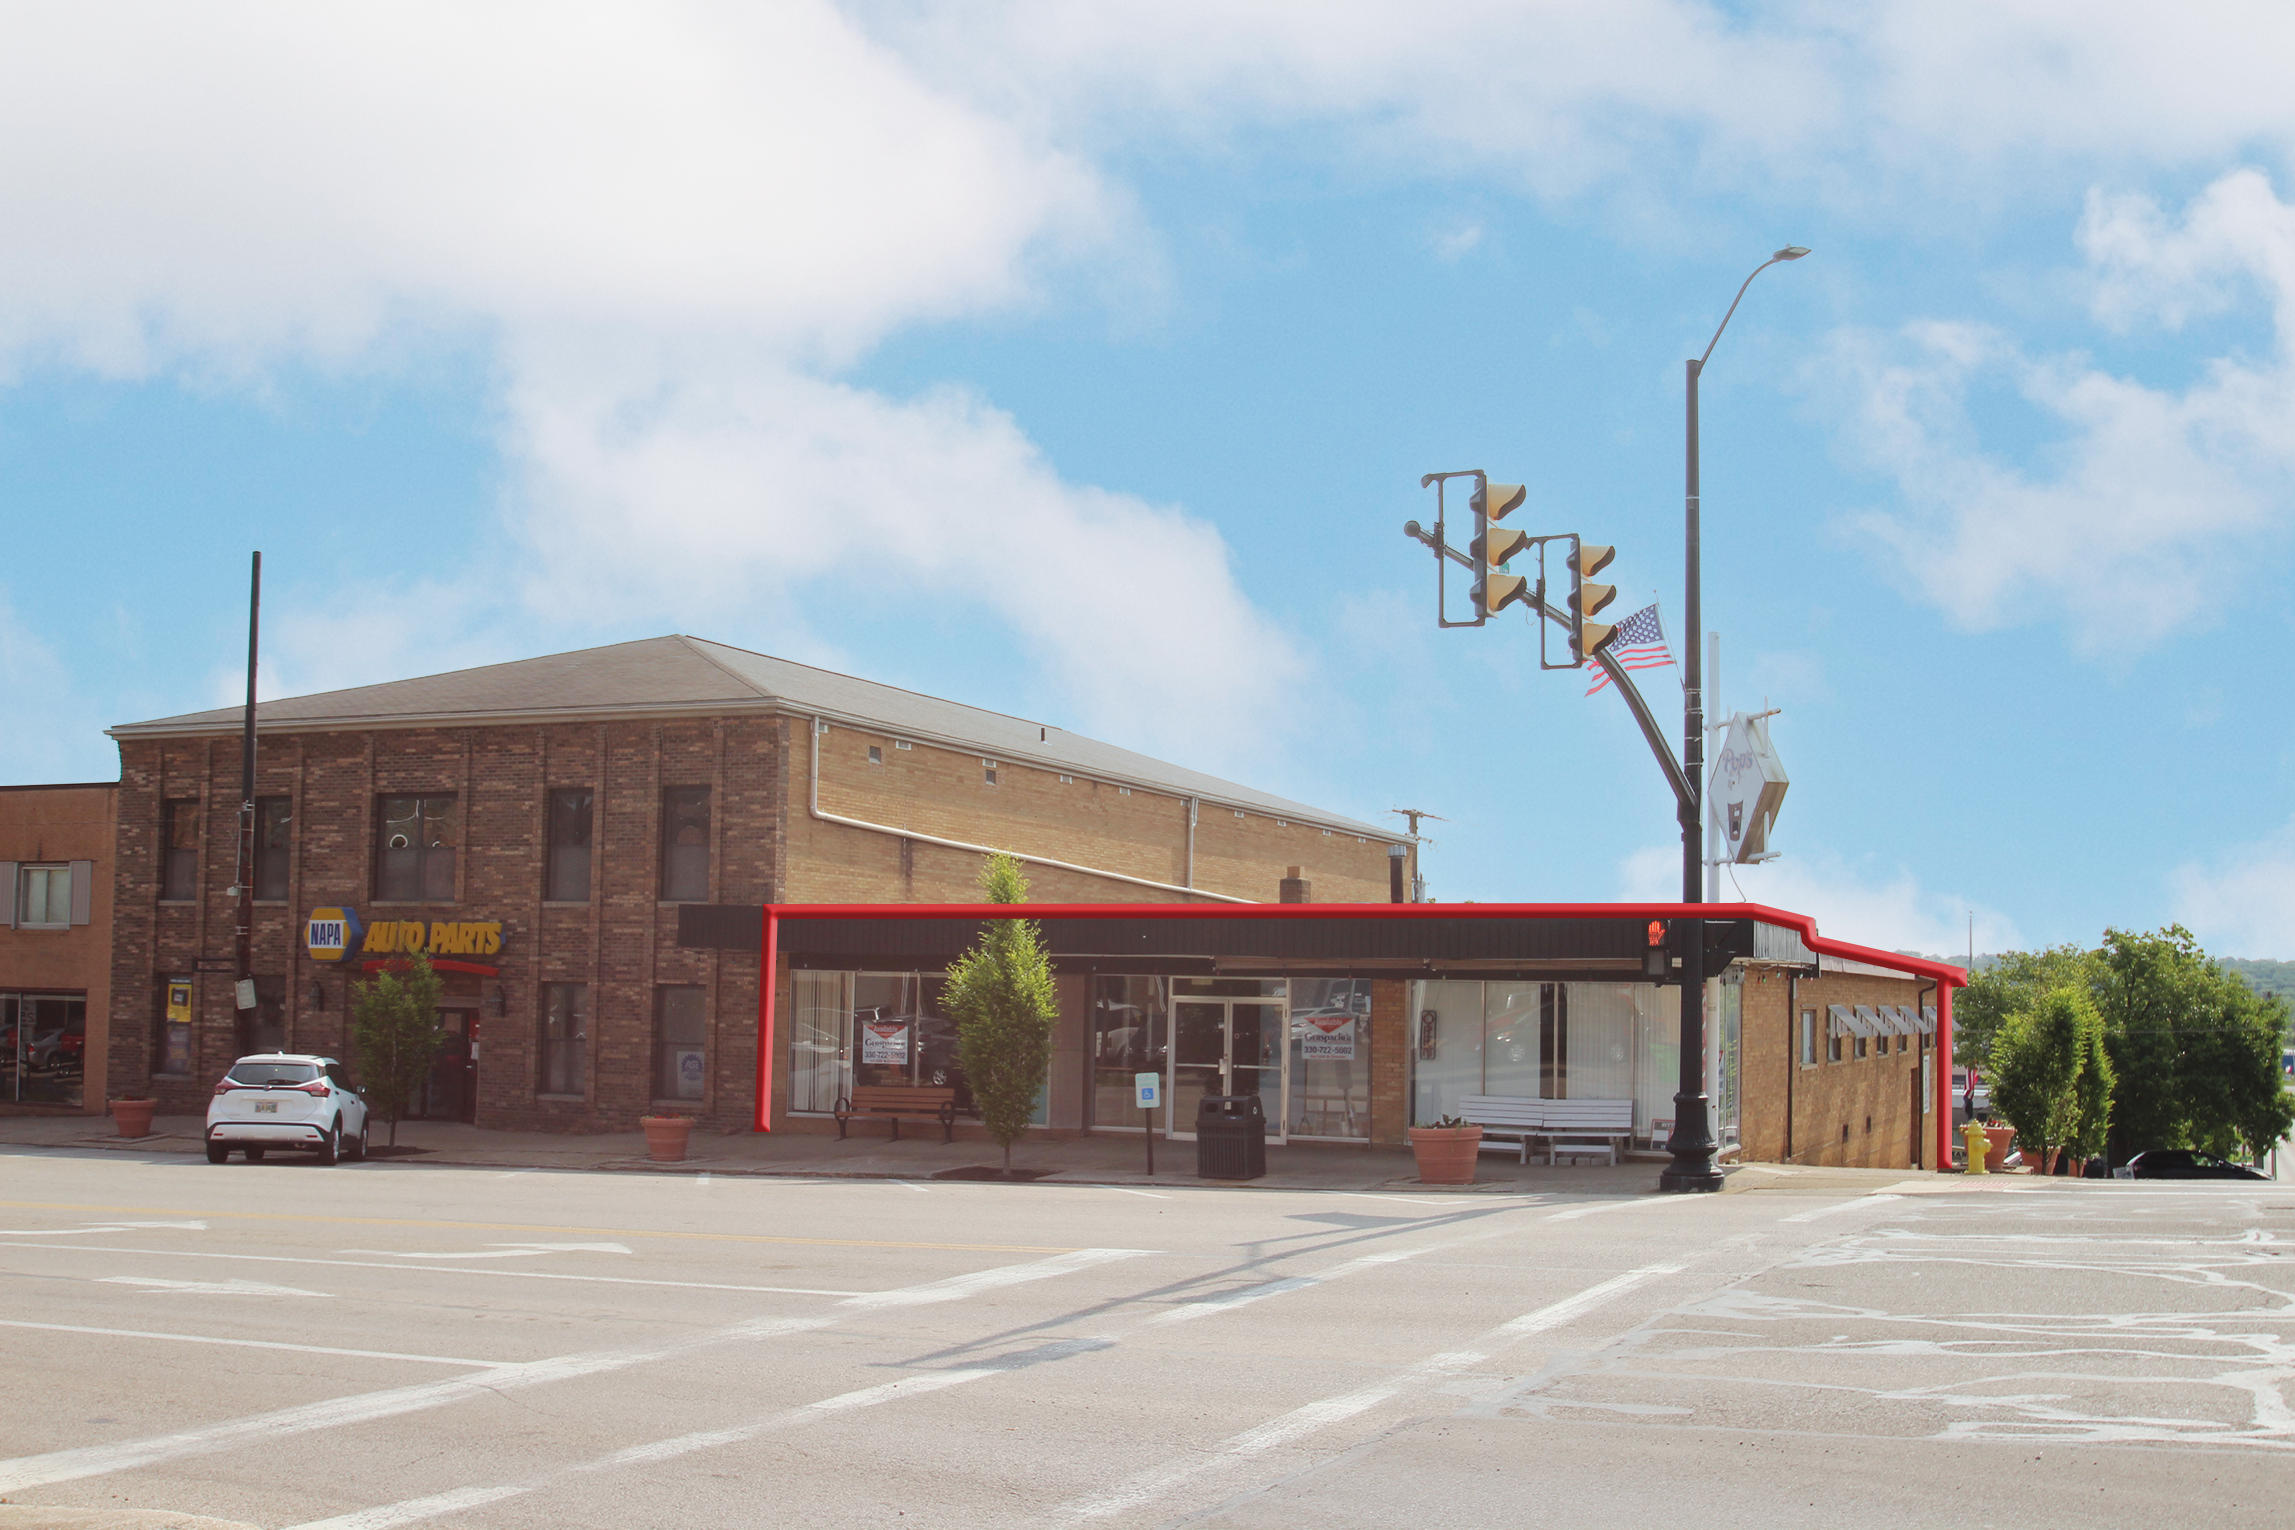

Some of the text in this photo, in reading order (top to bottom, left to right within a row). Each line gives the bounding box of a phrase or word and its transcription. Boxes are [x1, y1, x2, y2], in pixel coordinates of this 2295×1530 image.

[310, 923, 341, 946] NAPA
[362, 921, 502, 954] AUTO PARTS
[1314, 1018, 1343, 1026] Available
[873, 1025, 899, 1033] Available
[1303, 1046, 1352, 1055] 330-722-5002
[864, 1051, 906, 1059] 330-722-5002
